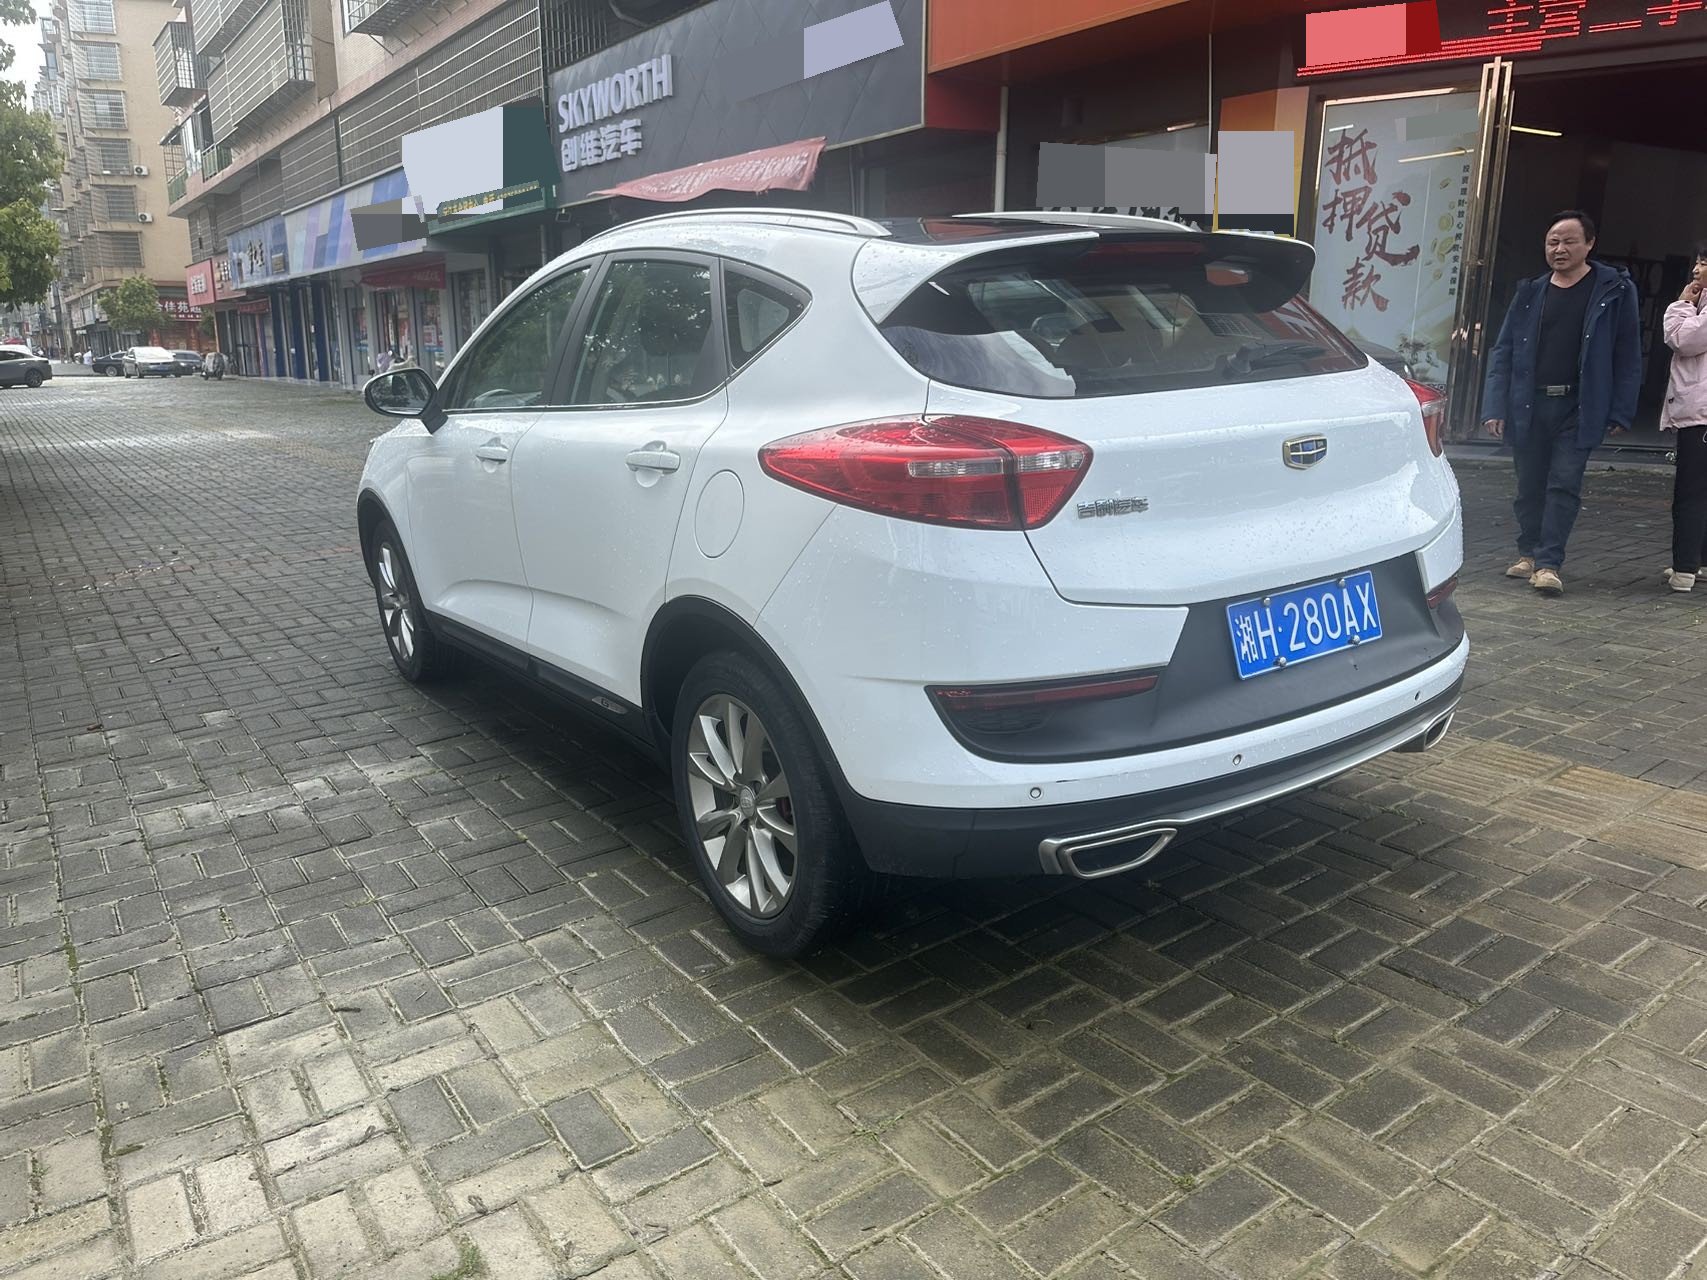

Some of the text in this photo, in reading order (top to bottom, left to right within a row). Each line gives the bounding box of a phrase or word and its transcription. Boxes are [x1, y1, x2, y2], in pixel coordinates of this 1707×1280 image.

[558, 54, 673, 133] SKYWORTH
[561, 119, 642, 172] 创维汽车
[1322, 128, 1420, 312] 抵押贷款
